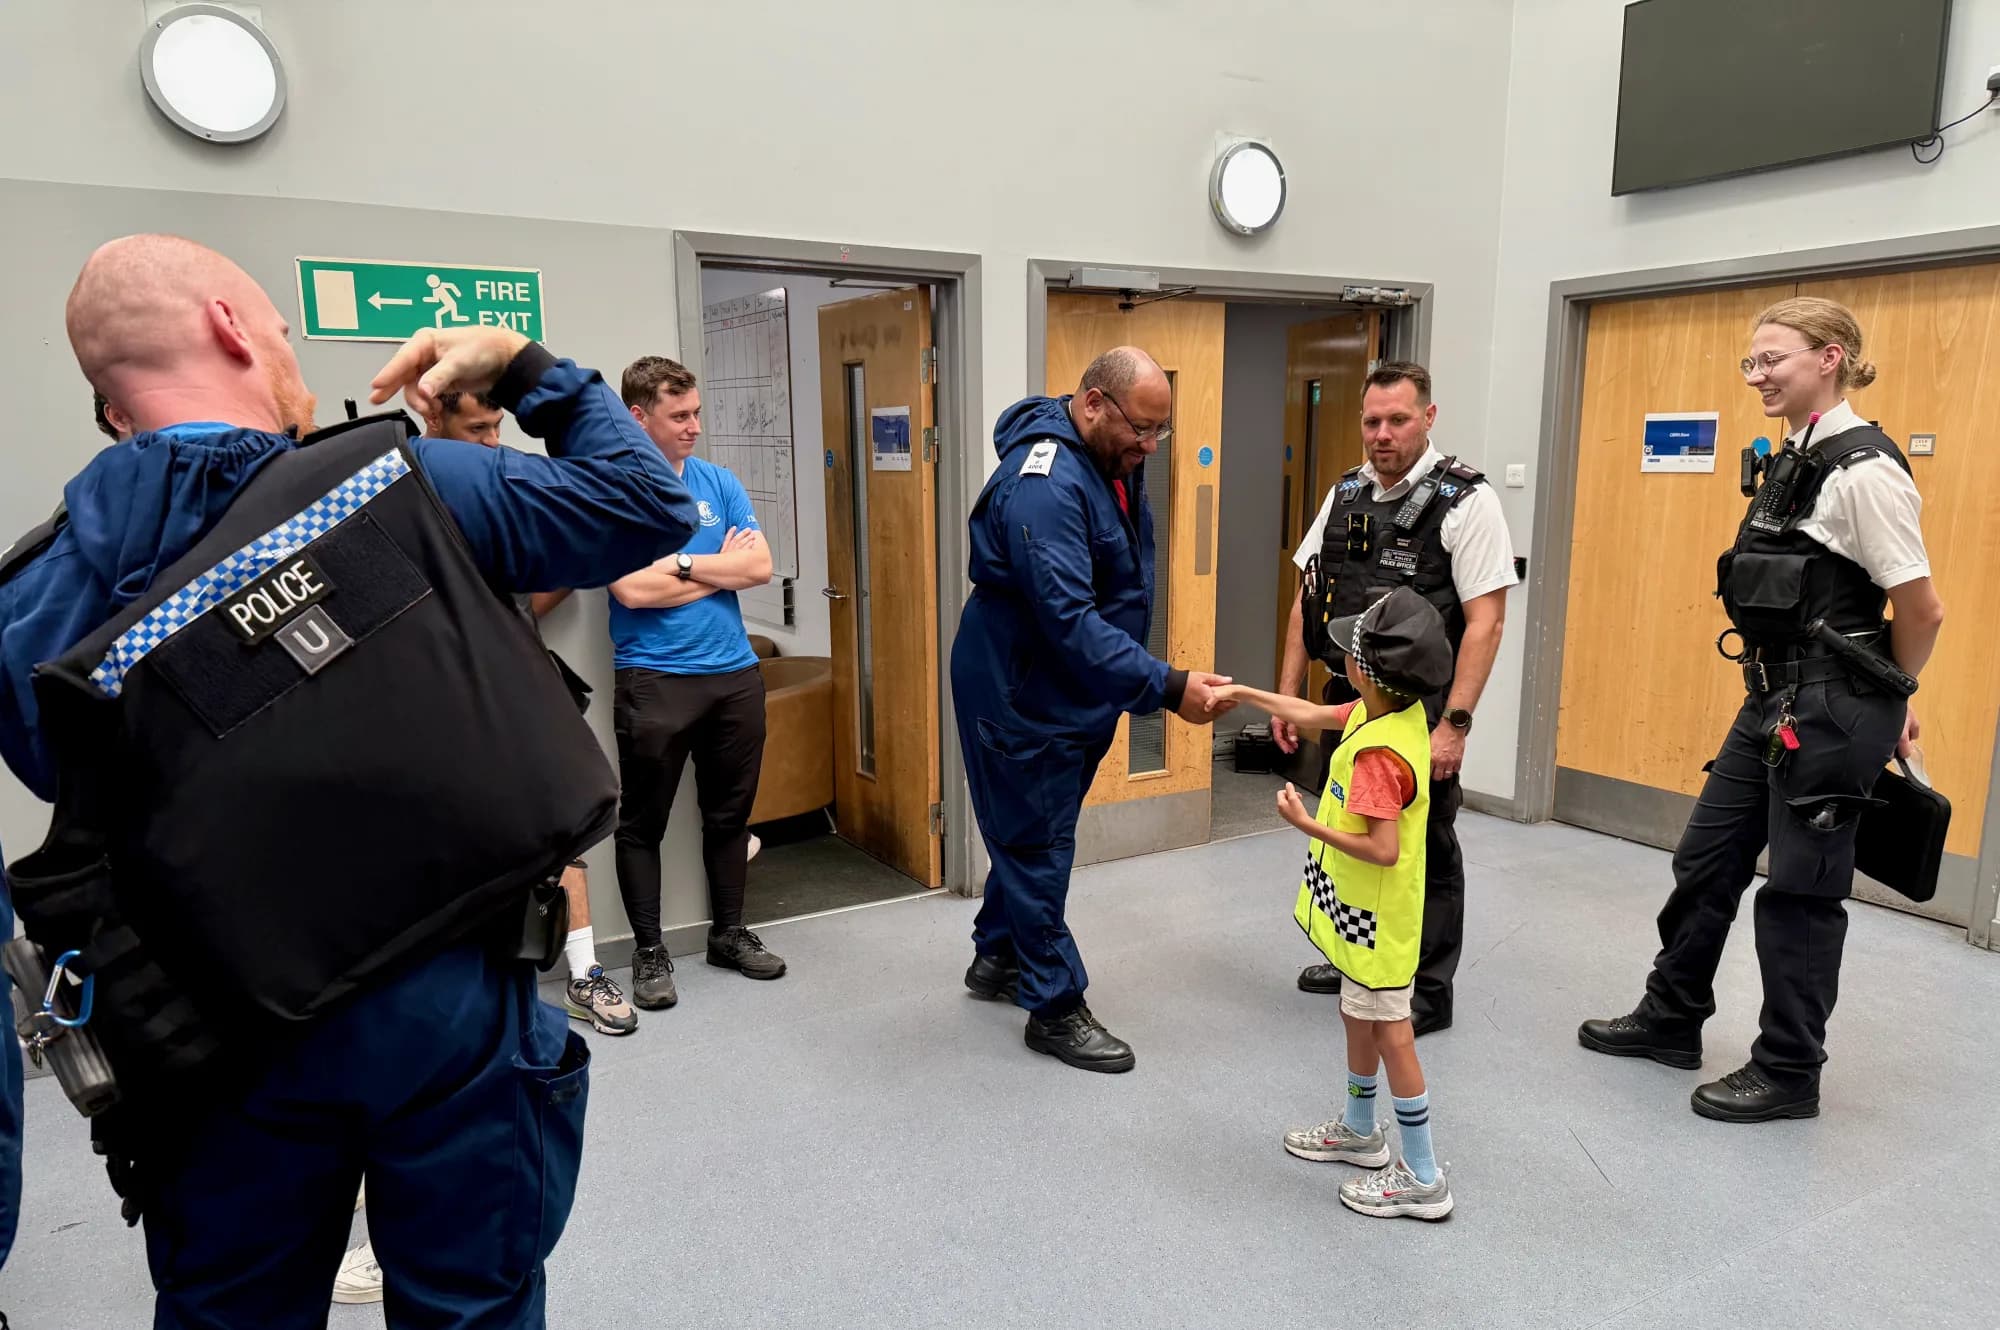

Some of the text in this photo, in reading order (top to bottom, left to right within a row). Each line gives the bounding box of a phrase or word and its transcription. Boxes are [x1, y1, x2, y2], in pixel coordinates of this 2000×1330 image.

[475, 280, 531, 302] FIRE
[478, 310, 532, 332] EXIT
[1379, 559, 1416, 570] POLICE OFFICER
[229, 559, 324, 637] POLICE
[291, 619, 330, 654] U
[1331, 781, 1344, 799] POL
